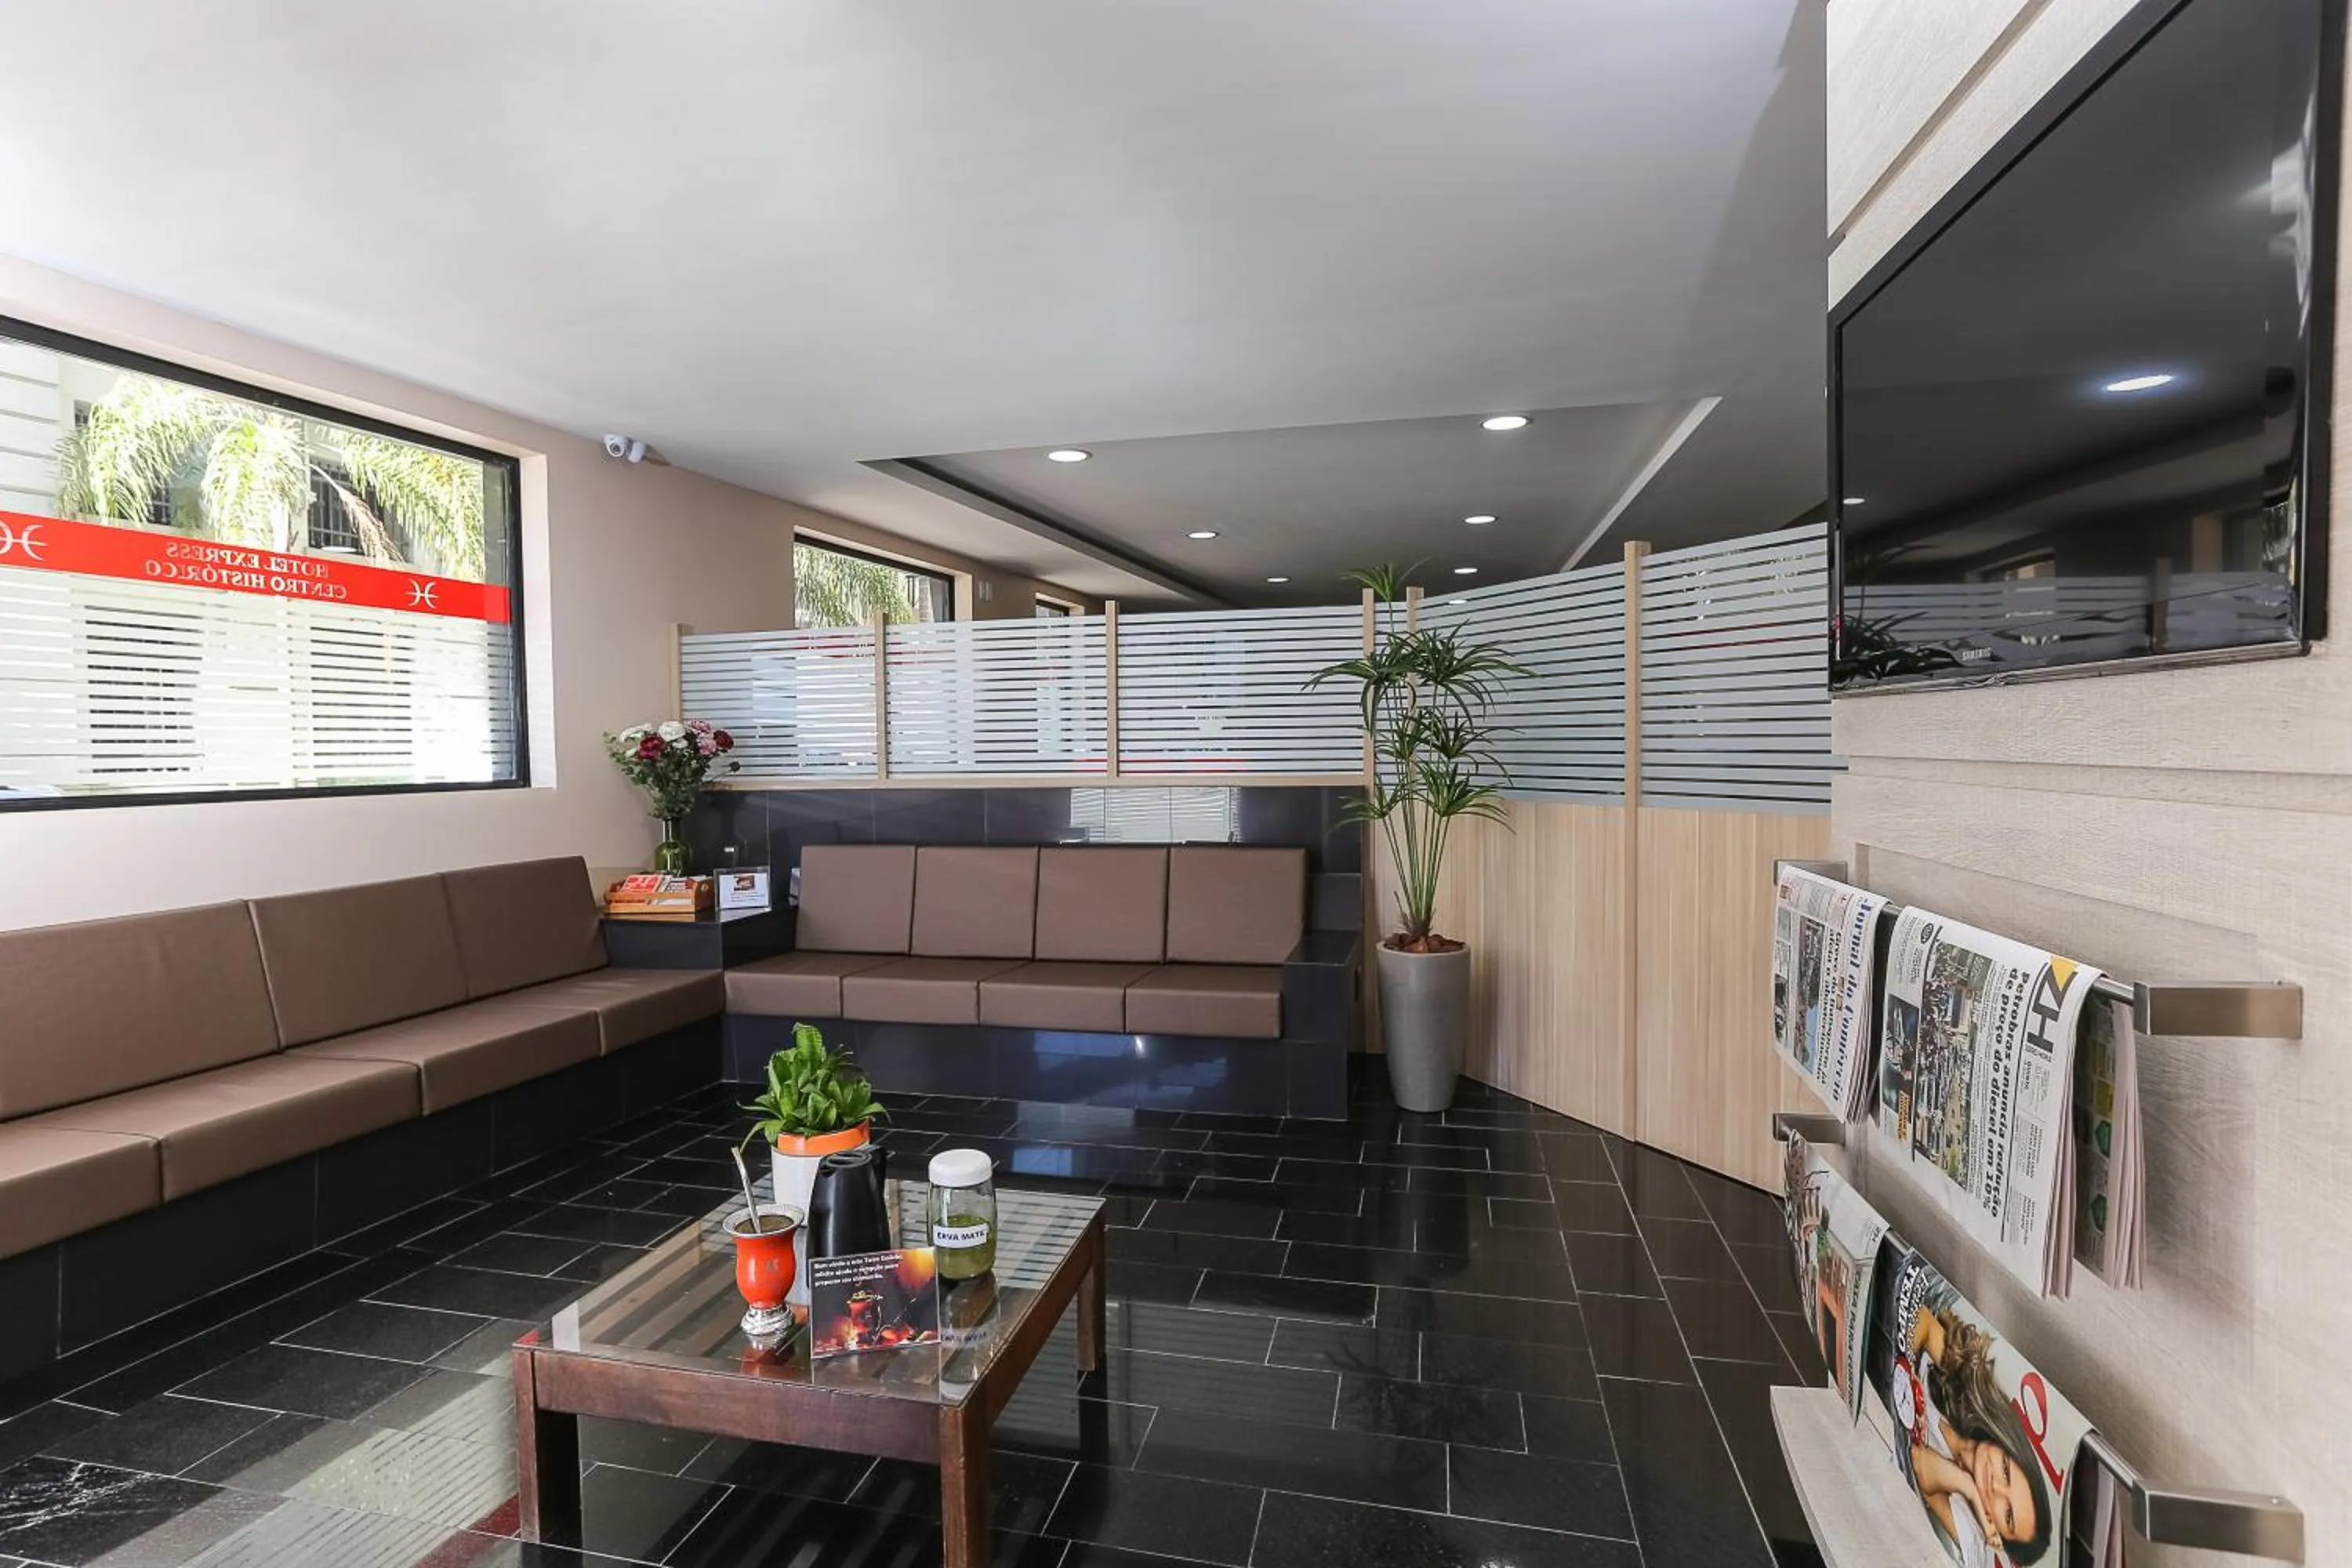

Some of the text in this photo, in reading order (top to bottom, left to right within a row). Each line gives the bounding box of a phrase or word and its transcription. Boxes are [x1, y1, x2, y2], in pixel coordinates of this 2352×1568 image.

[1832, 898, 1871, 1102] Jornal do Comércio
[2027, 958, 2078, 1054] ZH
[1983, 967, 2018, 1209] de preço do diesel em 10%
[1991, 971, 2031, 1218] Petrobras anuncia redução
[937, 1230, 985, 1240] ERVA MATE
[1897, 1264, 1920, 1353] TEMPO
